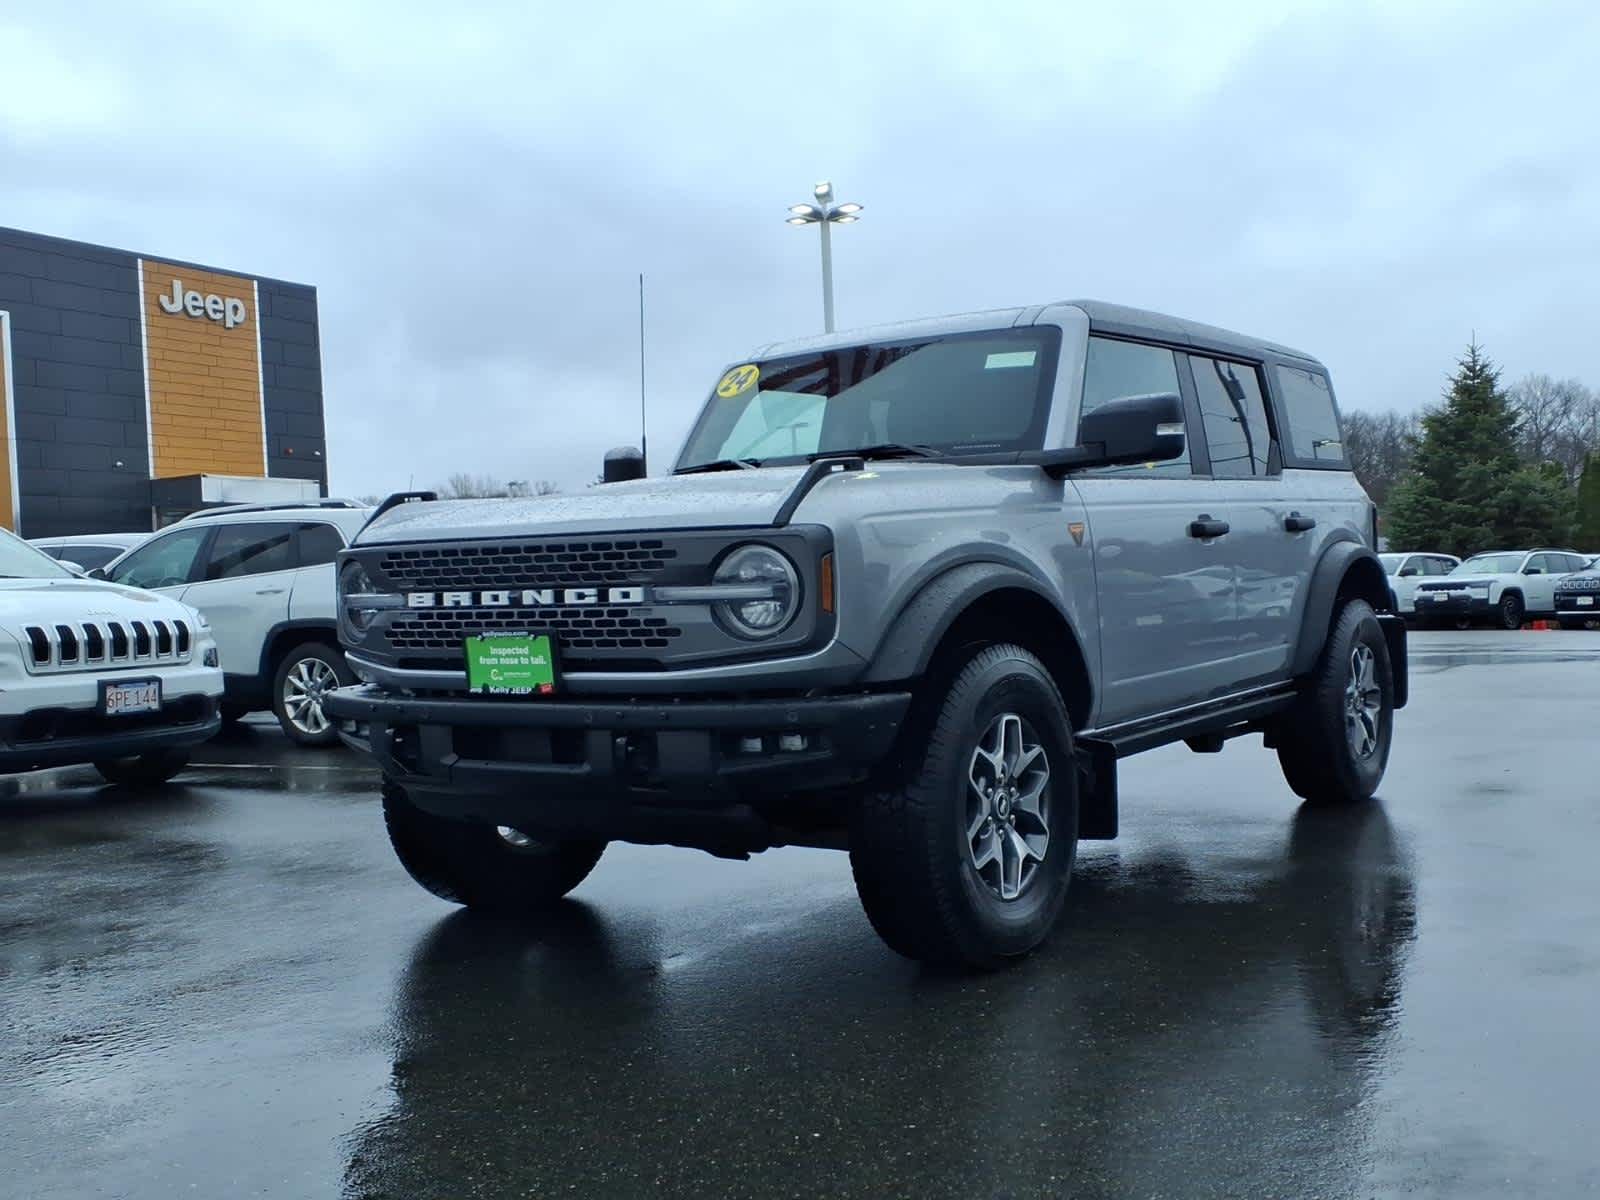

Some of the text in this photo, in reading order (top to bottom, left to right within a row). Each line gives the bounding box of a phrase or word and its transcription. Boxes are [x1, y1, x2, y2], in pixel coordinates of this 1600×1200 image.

[159, 279, 246, 329] Jeep
[720, 369, 755, 391] 24
[407, 587, 645, 608] BRONCO
[480, 656, 498, 664] from
[530, 656, 546, 664] tail.
[490, 646, 529, 656] Inspected
